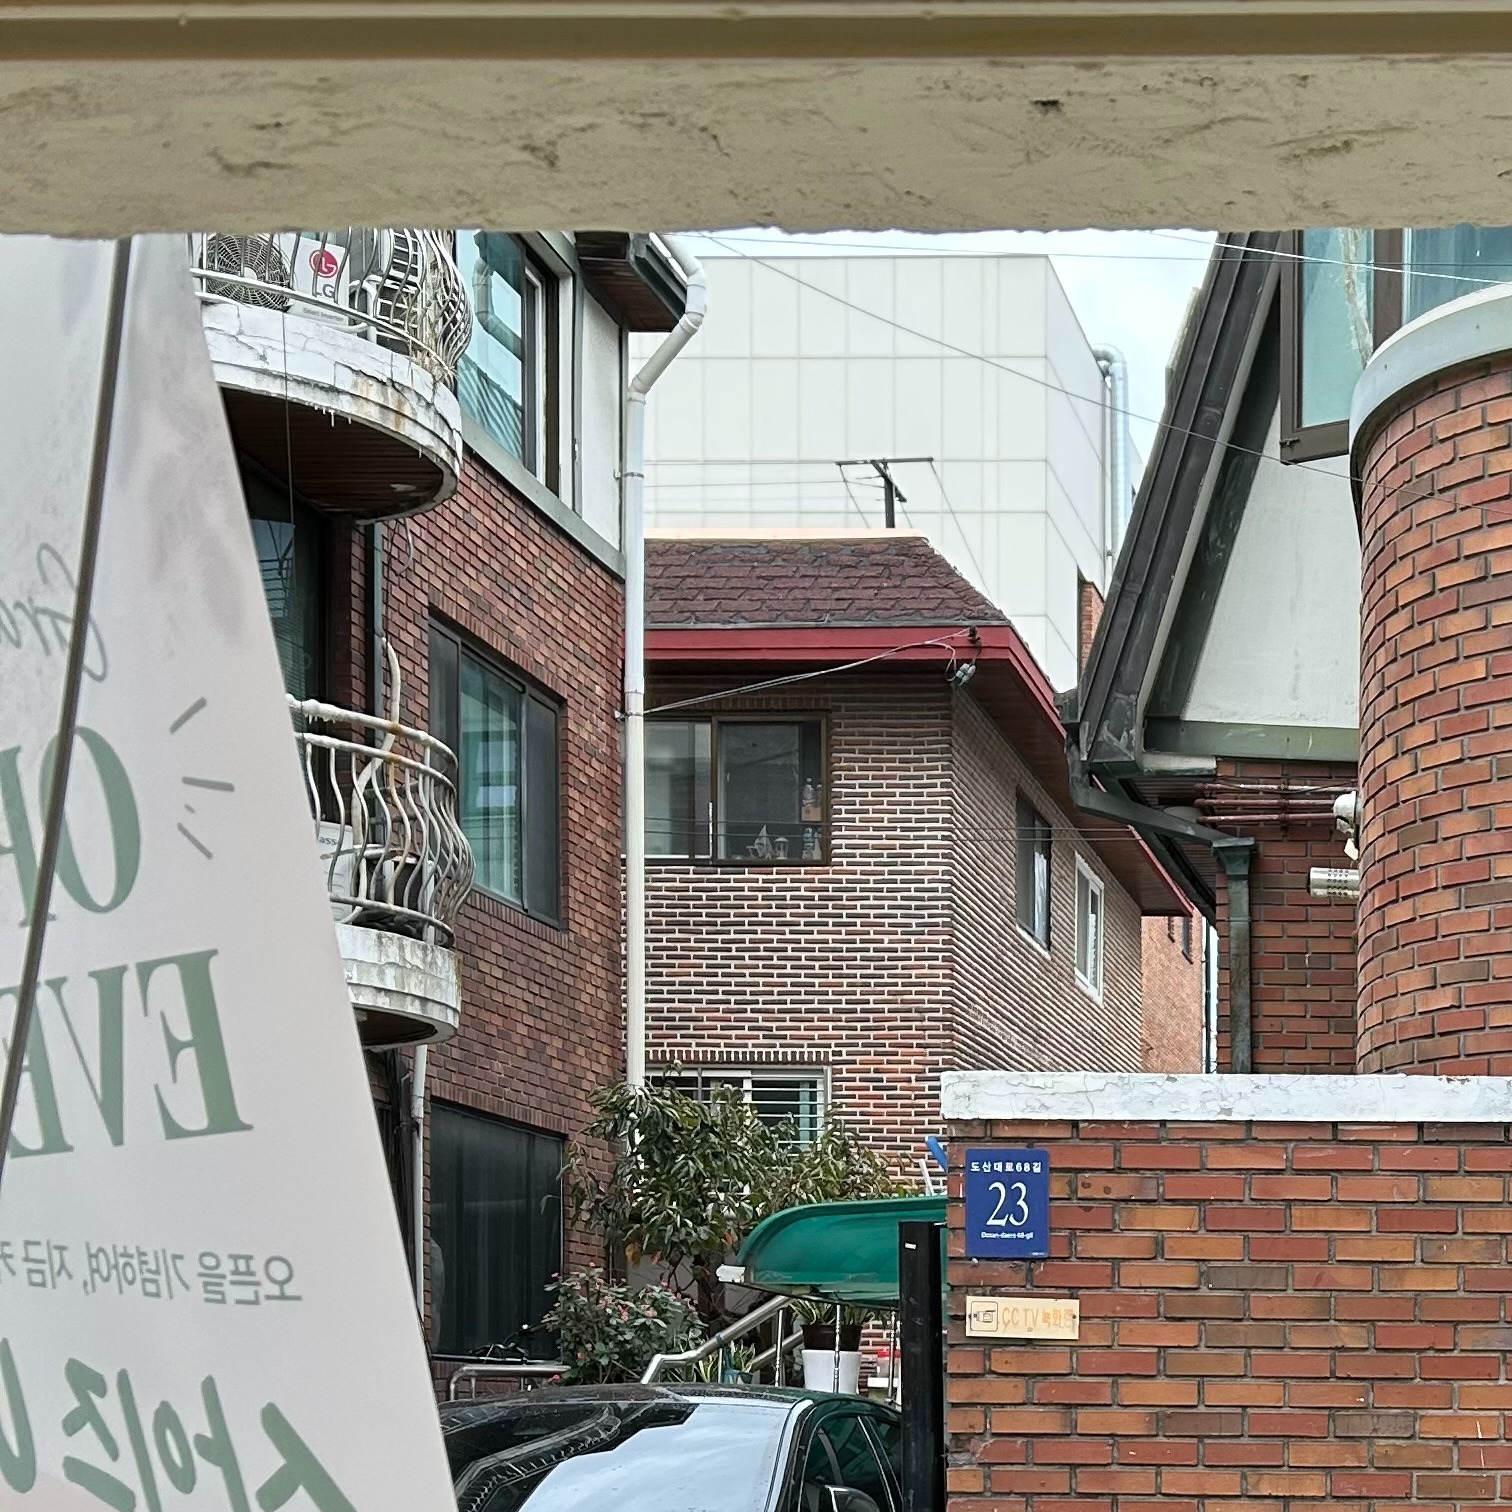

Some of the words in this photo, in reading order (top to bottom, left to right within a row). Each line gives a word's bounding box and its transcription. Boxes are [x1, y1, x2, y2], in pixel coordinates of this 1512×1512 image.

[970, 1161, 1041, 1173] 도산대로68길
[986, 1181, 1029, 1227] 23
[1002, 1307, 1039, 1328] CCTV
